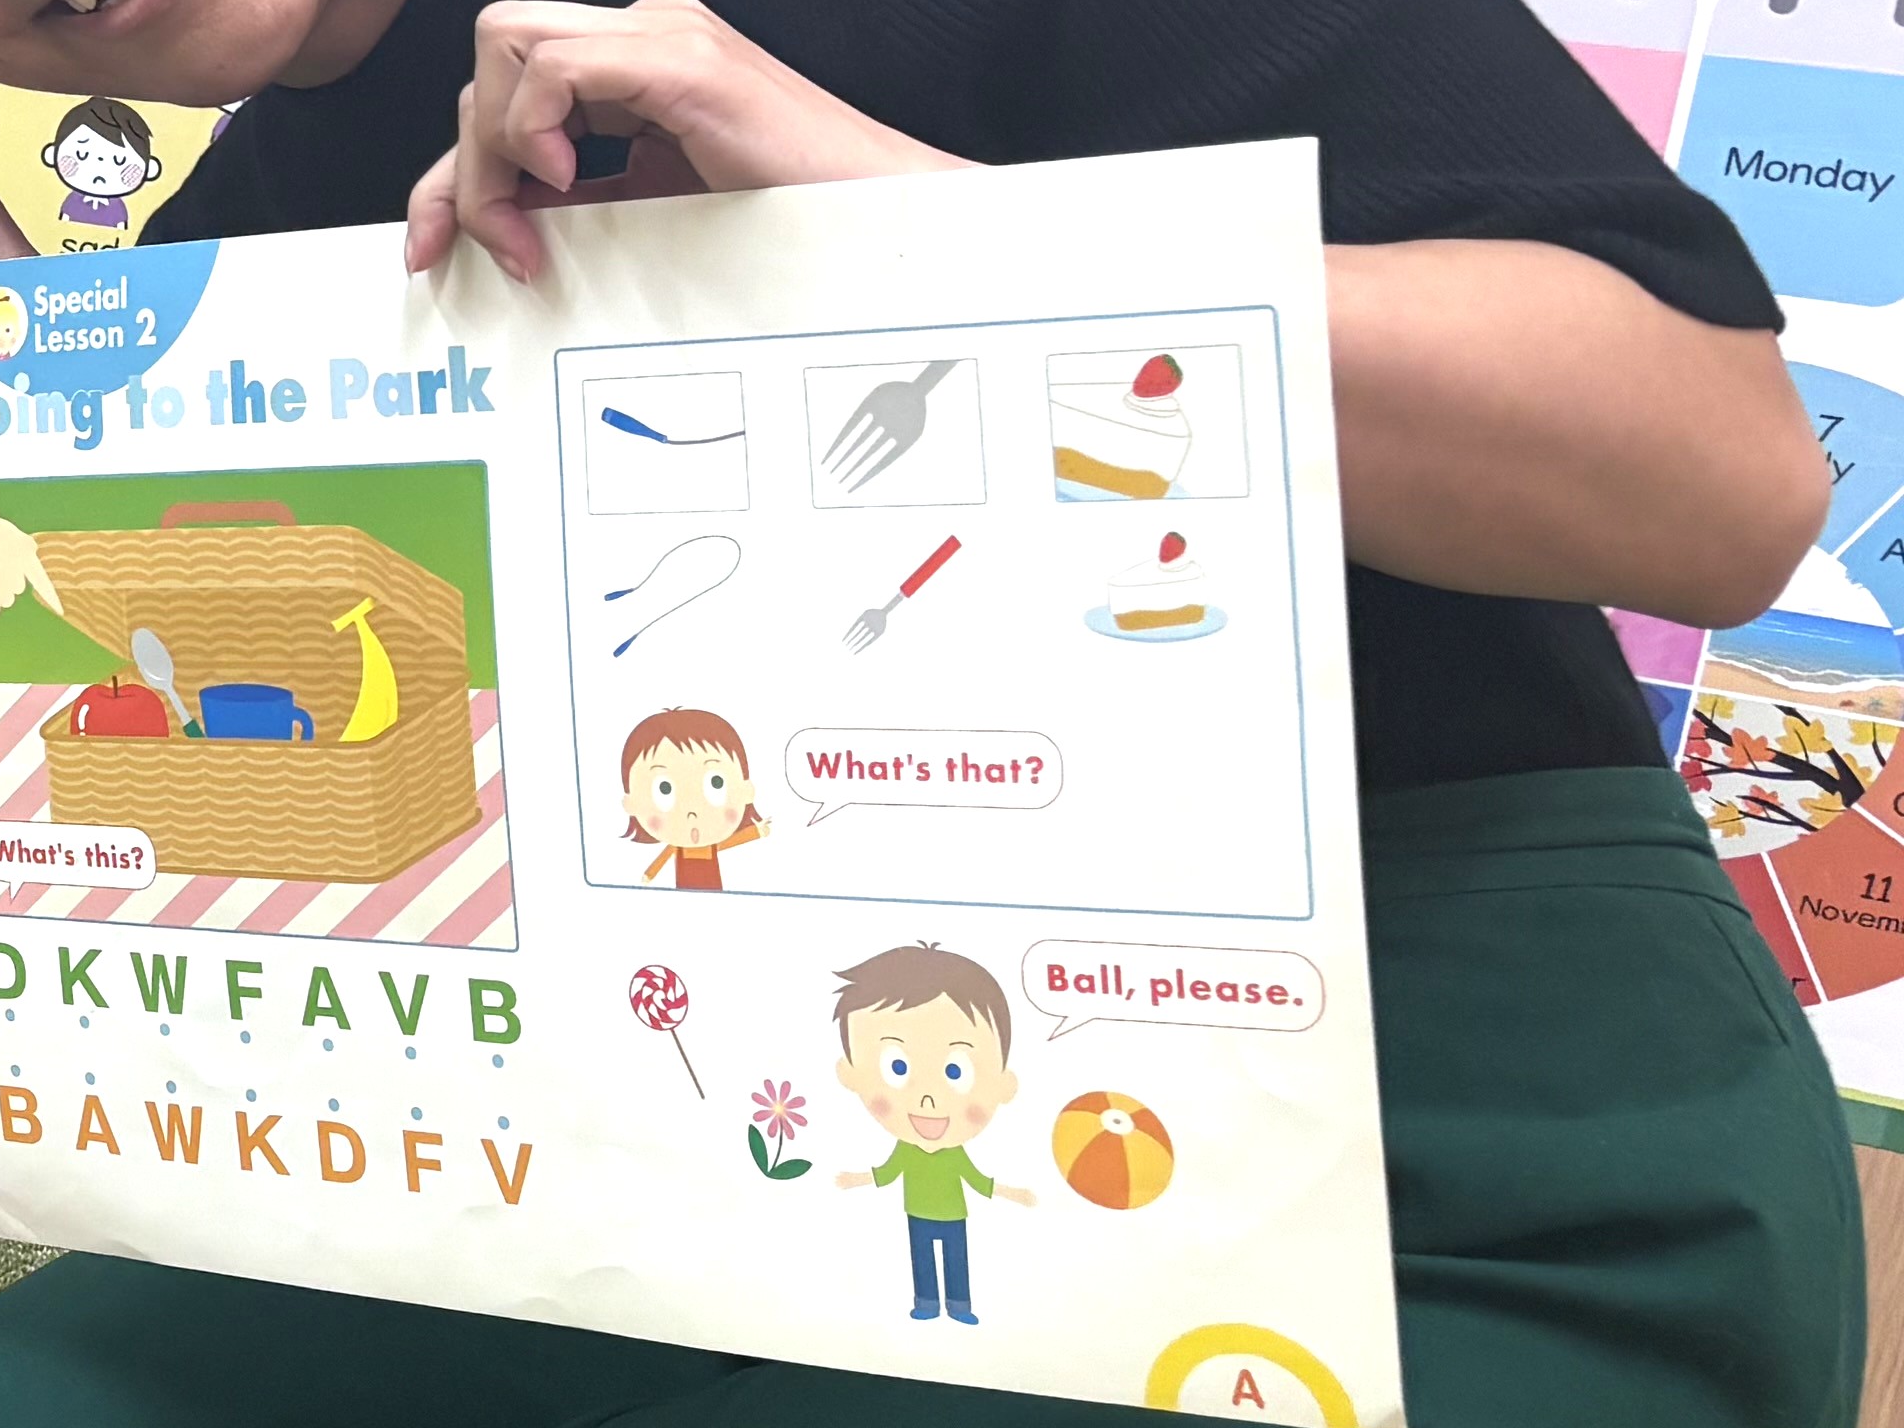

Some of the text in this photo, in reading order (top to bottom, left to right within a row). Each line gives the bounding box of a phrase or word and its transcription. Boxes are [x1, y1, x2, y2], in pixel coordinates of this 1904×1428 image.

[1724, 147, 1895, 203] Monday
[33, 275, 127, 323] Special
[34, 309, 157, 353] Lesson 2
[125, 375, 185, 429] to
[205, 359, 307, 425] the
[329, 346, 495, 419] Park
[1819, 414, 1845, 442] 7
[806, 751, 1044, 785] What's that?
[84, 842, 144, 870] this?
[1860, 873, 1892, 903] 11
[1800, 895, 1904, 934] Novem
[58, 947, 109, 1009] K
[131, 952, 187, 1015] W
[225, 960, 263, 1020] F
[302, 967, 351, 1030] A
[379, 971, 430, 1036] V
[468, 978, 521, 1045] B
[1046, 963, 1304, 1008] Ball, please.
[76, 1094, 121, 1156] A
[145, 1101, 202, 1165] W
[235, 1111, 290, 1176] K
[317, 1120, 366, 1184] D
[403, 1130, 443, 1193] F
[480, 1138, 533, 1205] V
[1231, 1368, 1264, 1409] A
